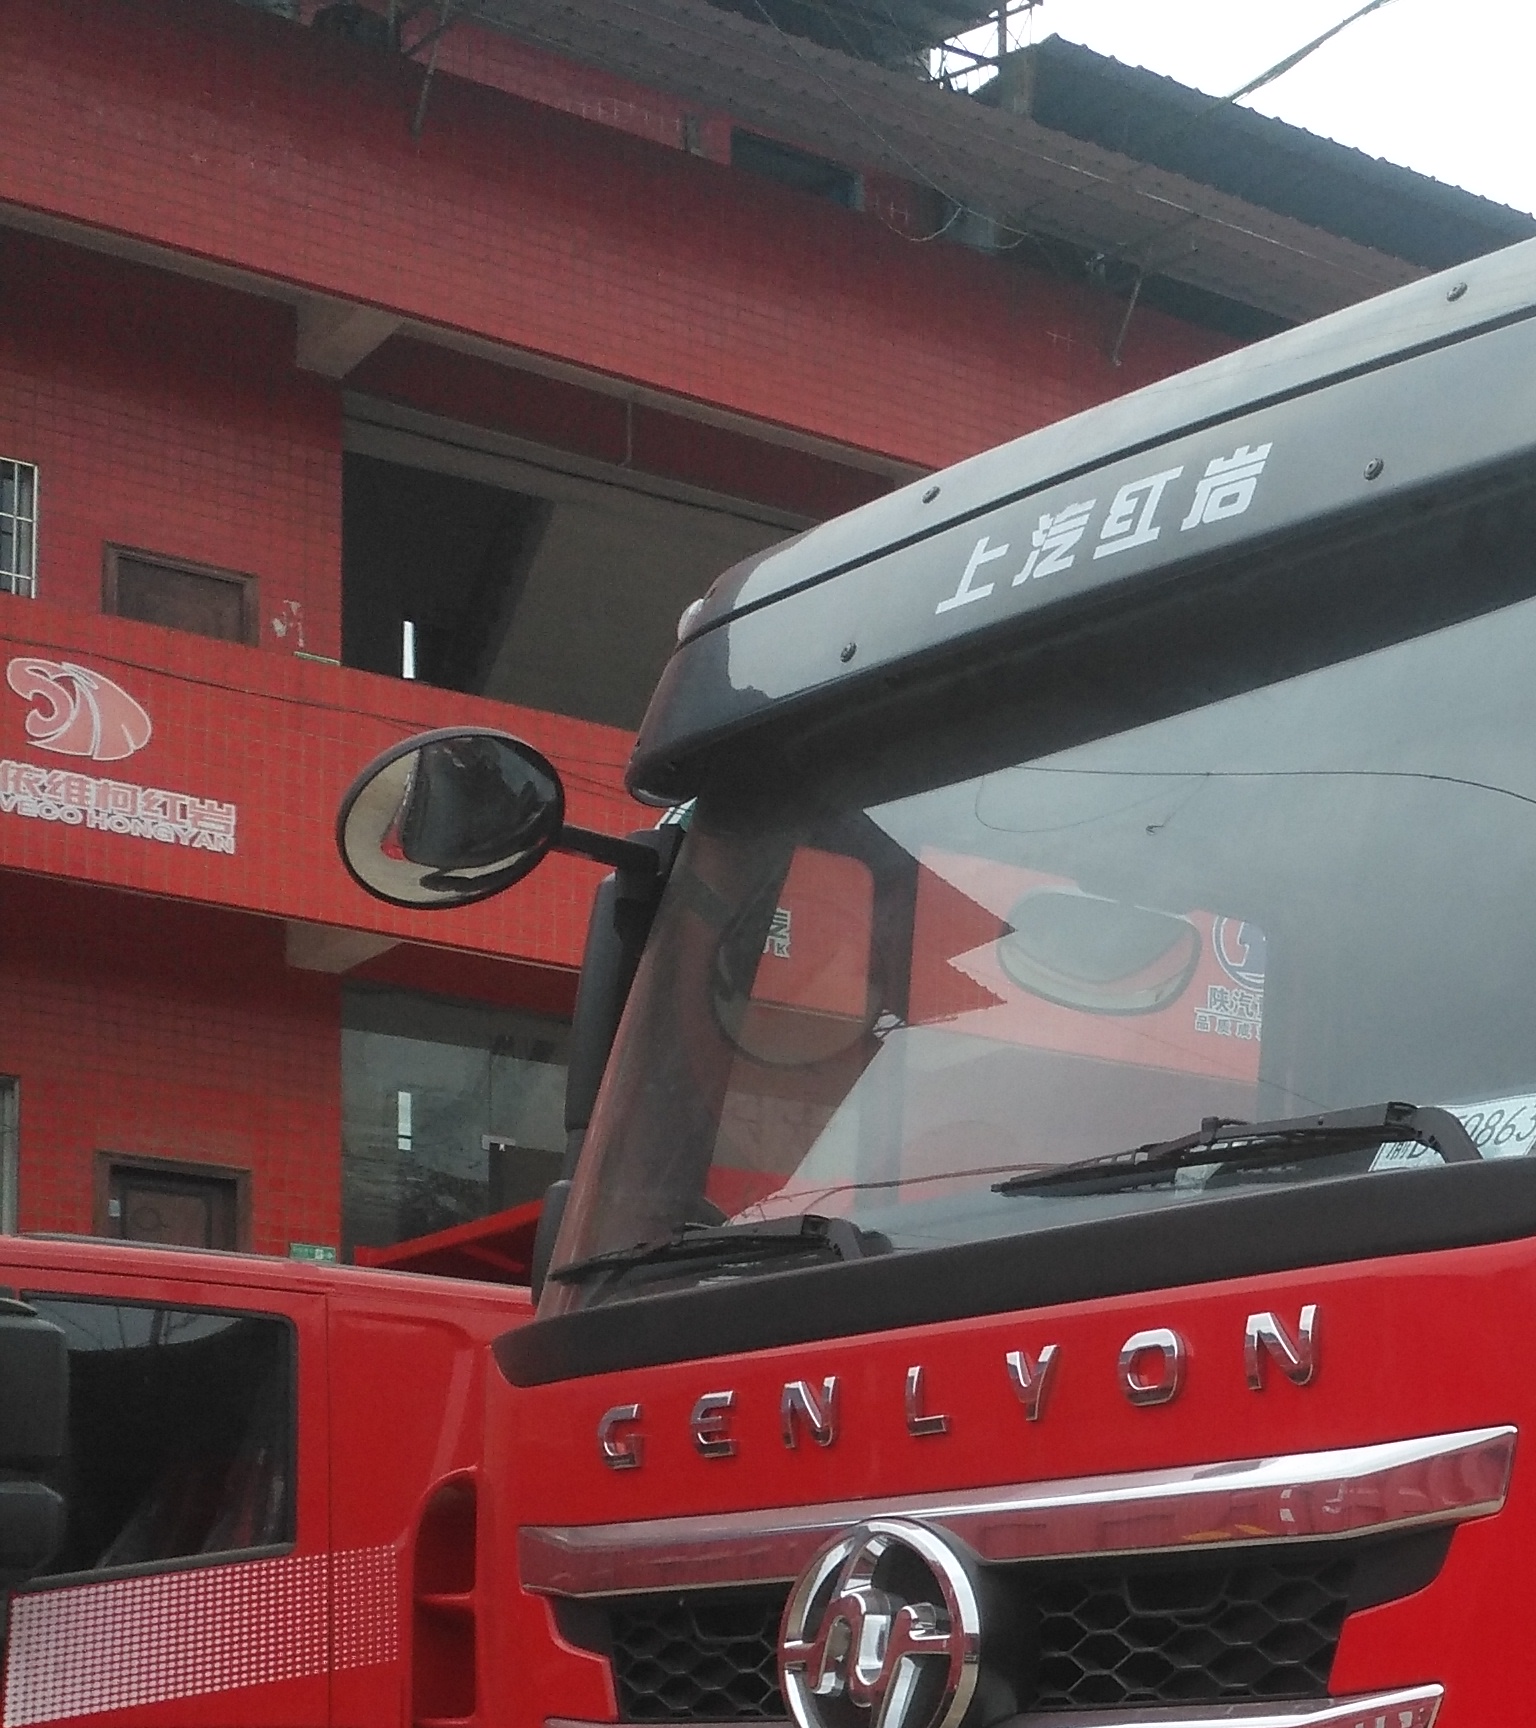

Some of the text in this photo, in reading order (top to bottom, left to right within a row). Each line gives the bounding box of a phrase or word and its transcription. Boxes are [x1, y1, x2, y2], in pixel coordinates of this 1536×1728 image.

[935, 442, 1273, 615] 上汽红岩
[0, 759, 236, 836] 依维柯红岩
[86, 807, 235, 854] HONGYAN
[598, 1304, 1322, 1469] GENLYON
